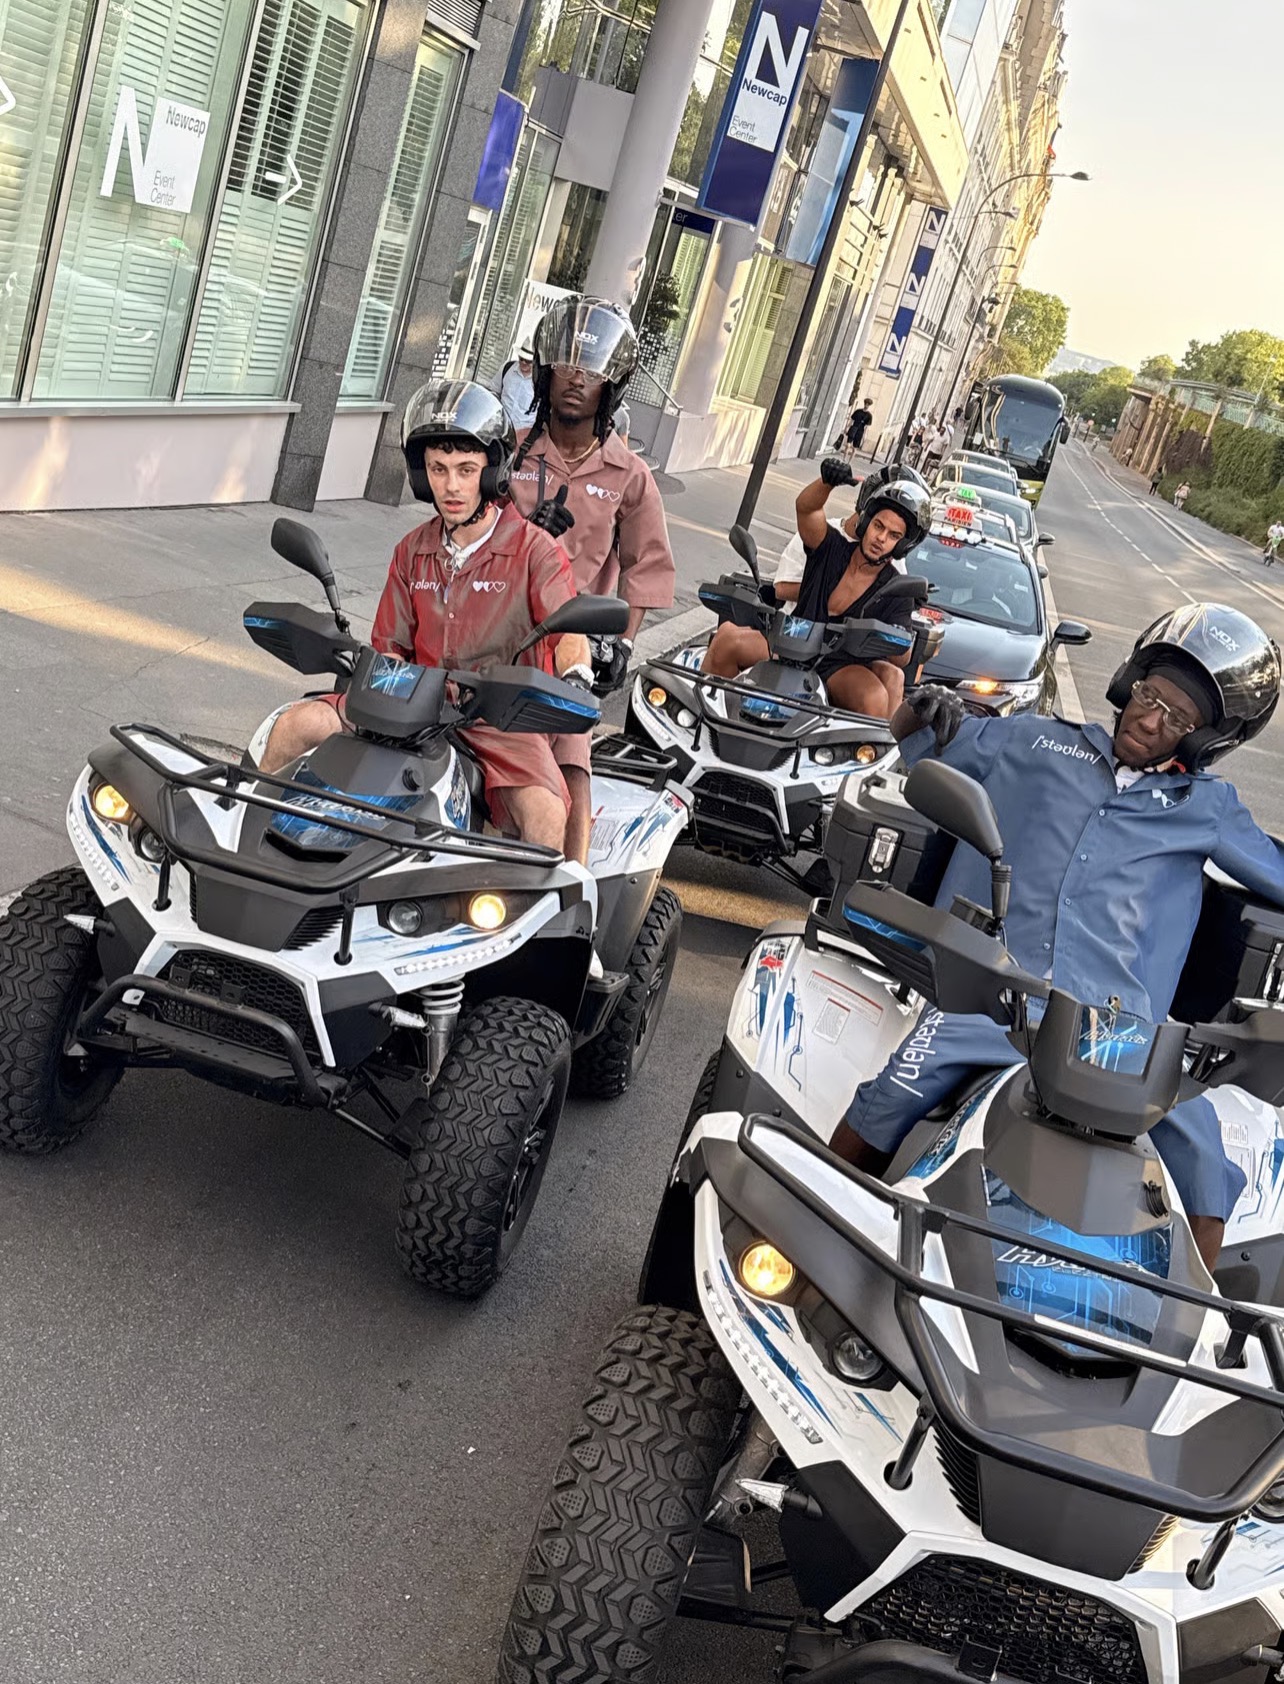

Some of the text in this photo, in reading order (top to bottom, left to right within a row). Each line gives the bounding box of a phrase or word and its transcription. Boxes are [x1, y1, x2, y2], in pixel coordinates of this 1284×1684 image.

[743, 10, 810, 91] N
[742, 77, 788, 107] Newcap
[165, 105, 207, 138] Newcap
[731, 115, 756, 132] Event
[728, 126, 758, 143] Center
[153, 169, 176, 189] Event
[150, 187, 177, 206] Center
[525, 286, 562, 314] Newc
[576, 331, 600, 343] NOX
[431, 411, 458, 421] NOX
[951, 508, 972, 521] TAXI
[1209, 625, 1241, 652] NOX
